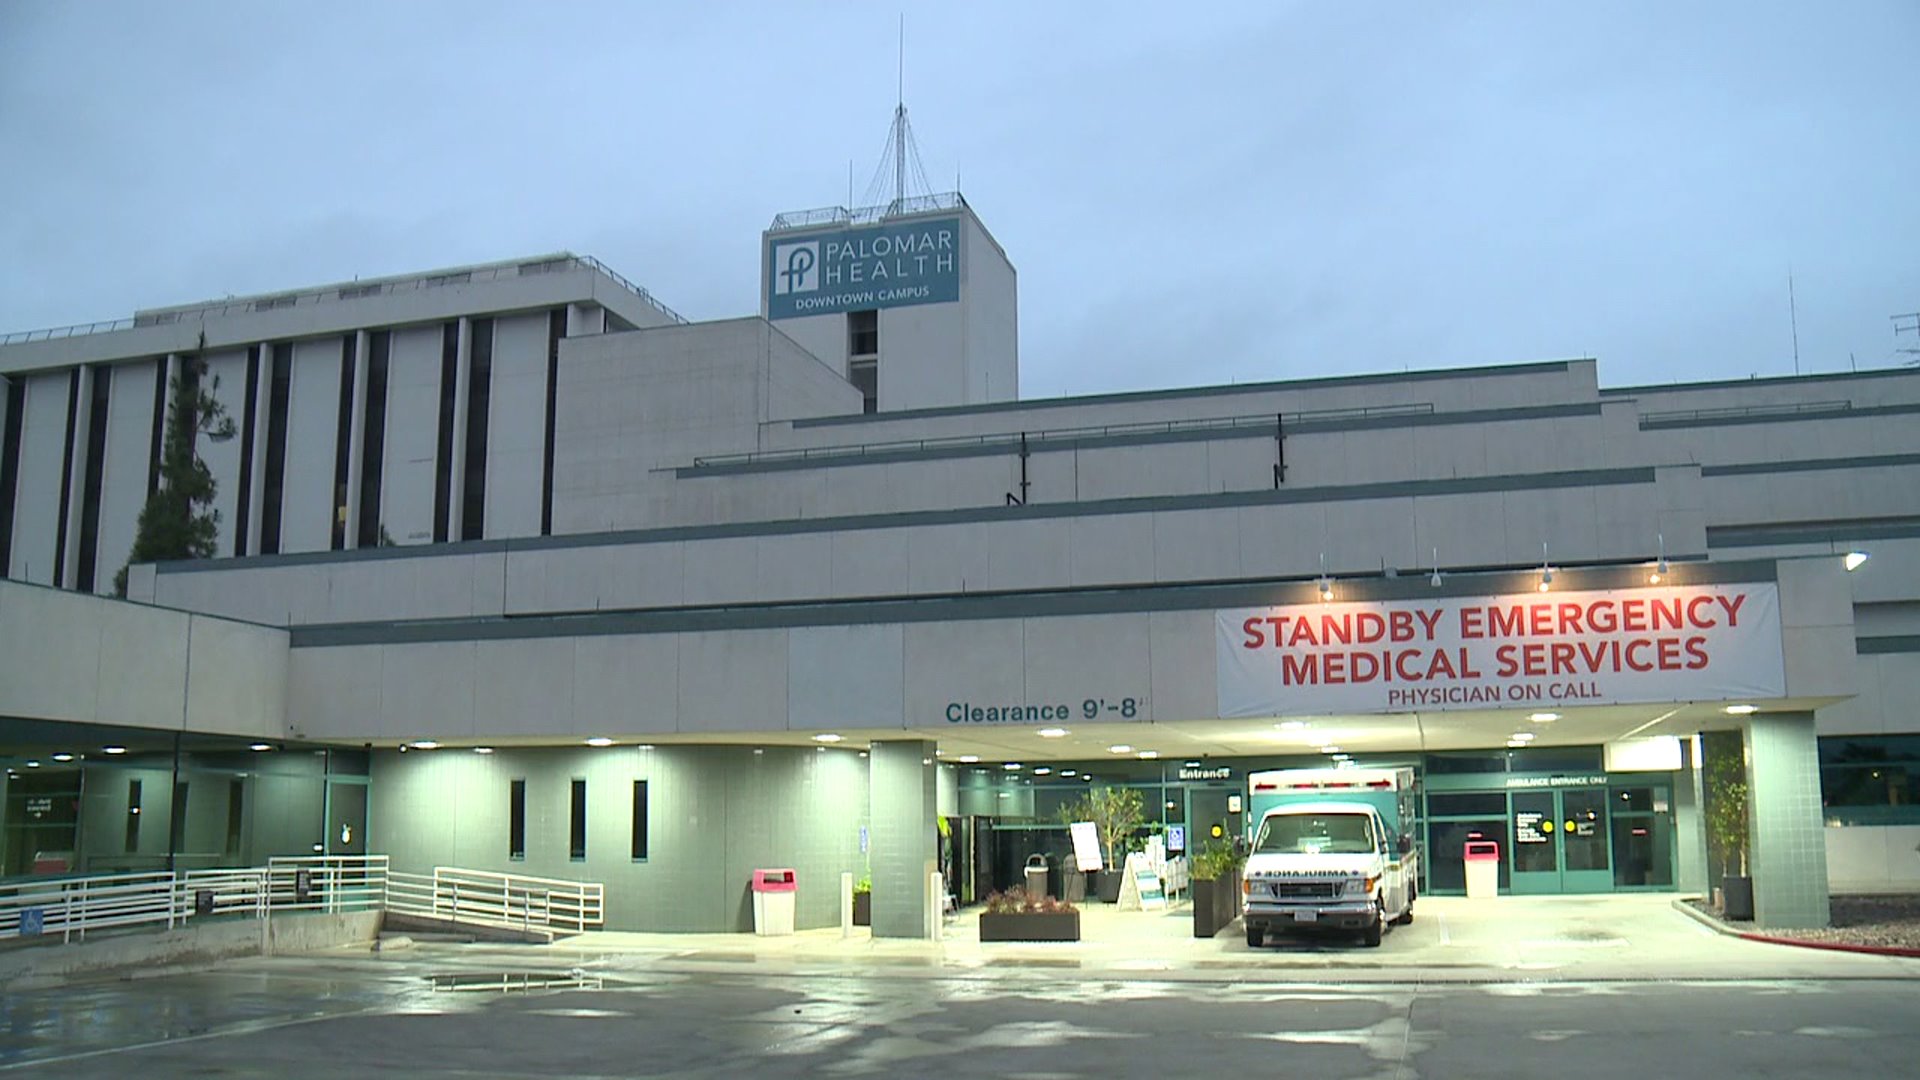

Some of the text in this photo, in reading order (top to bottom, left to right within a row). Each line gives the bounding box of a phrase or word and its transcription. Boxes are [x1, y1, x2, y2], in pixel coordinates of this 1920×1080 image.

[826, 230, 952, 262] PALOMAR
[826, 253, 952, 285] HEALTH
[796, 285, 930, 310] DOWNTOWN CAMPUS
[1243, 594, 1746, 649] STANDBY EMERGENCY
[1282, 636, 1709, 686] MEDICAL SERVICES
[1388, 682, 1602, 705] PHYSICIAN ON CALL
[946, 703, 1070, 722] Clearance
[1179, 768, 1230, 779] Entrance
